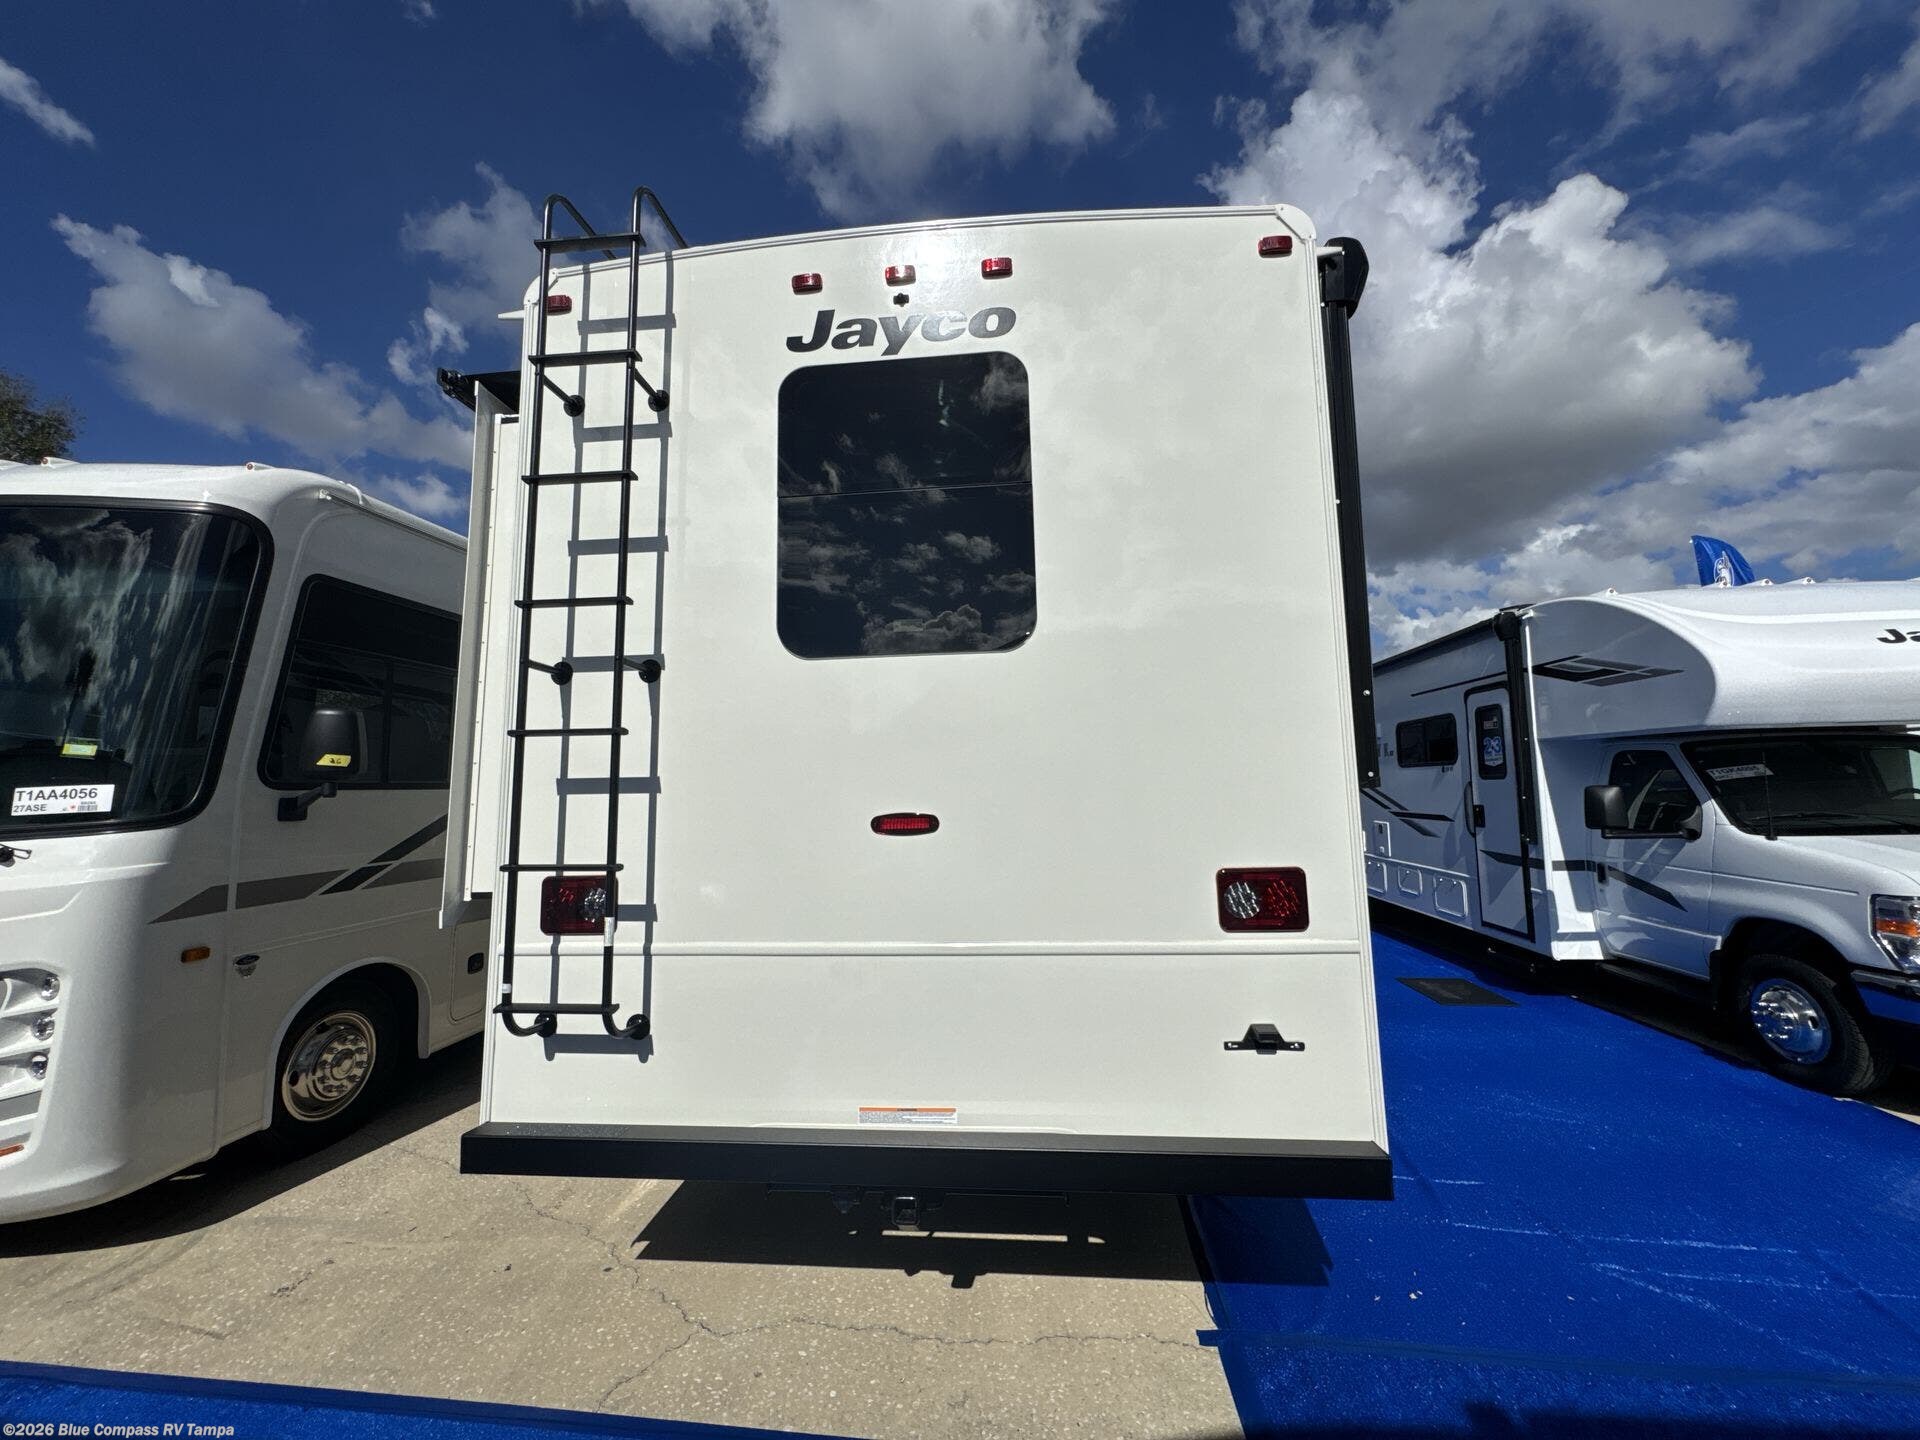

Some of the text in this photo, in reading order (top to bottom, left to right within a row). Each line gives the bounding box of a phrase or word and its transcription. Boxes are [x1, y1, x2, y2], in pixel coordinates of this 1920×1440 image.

[786, 307, 1017, 356] Jayco
[16, 788, 98, 802] T1AA4056
[13, 804, 48, 813] 27ASE
